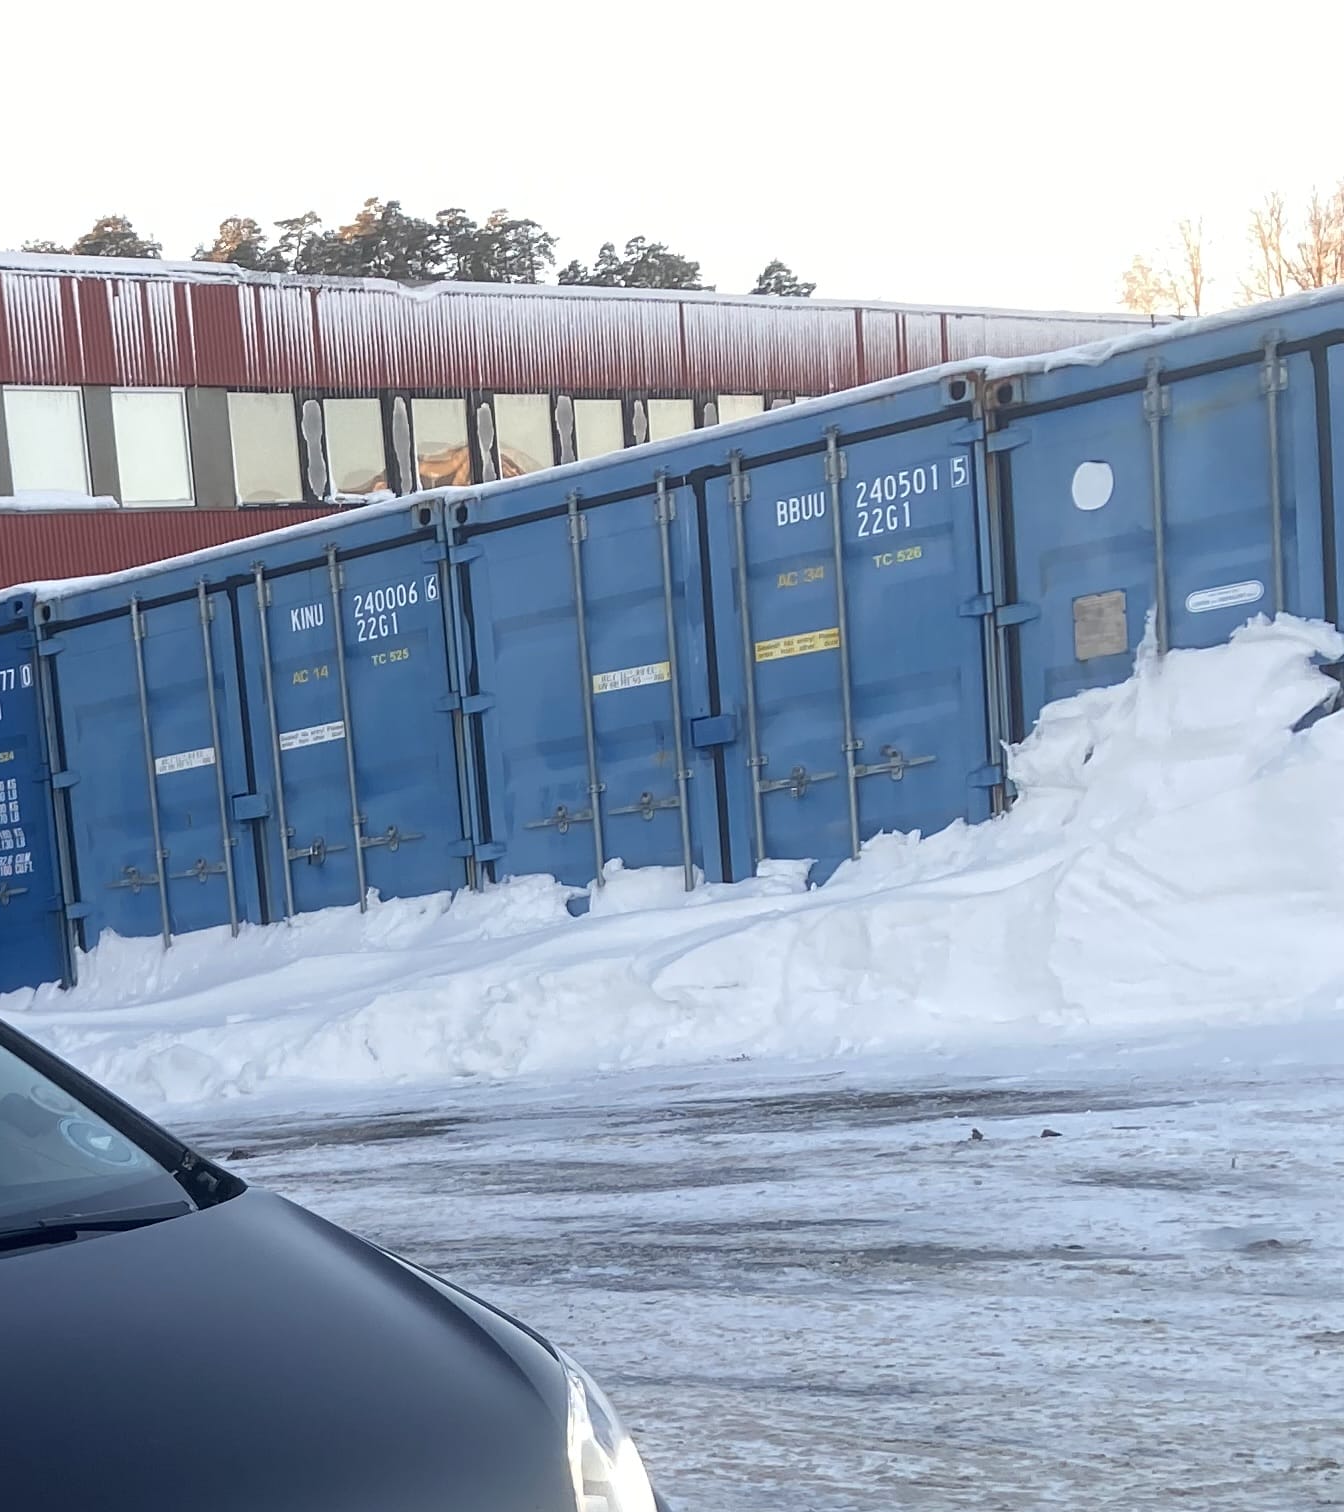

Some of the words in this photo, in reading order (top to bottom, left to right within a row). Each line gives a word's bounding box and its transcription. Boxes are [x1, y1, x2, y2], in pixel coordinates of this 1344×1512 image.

[777, 491, 826, 526] BBUU
[855, 463, 939, 509] 240501
[952, 456, 967, 487] 5
[857, 501, 912, 537] 22G1
[872, 553, 893, 569] TC
[291, 603, 324, 632] KINU
[353, 580, 418, 618] 240006
[426, 574, 438, 601] 6
[357, 611, 398, 642] 22G1
[371, 653, 387, 667] TC
[21, 665, 31, 687] 0
